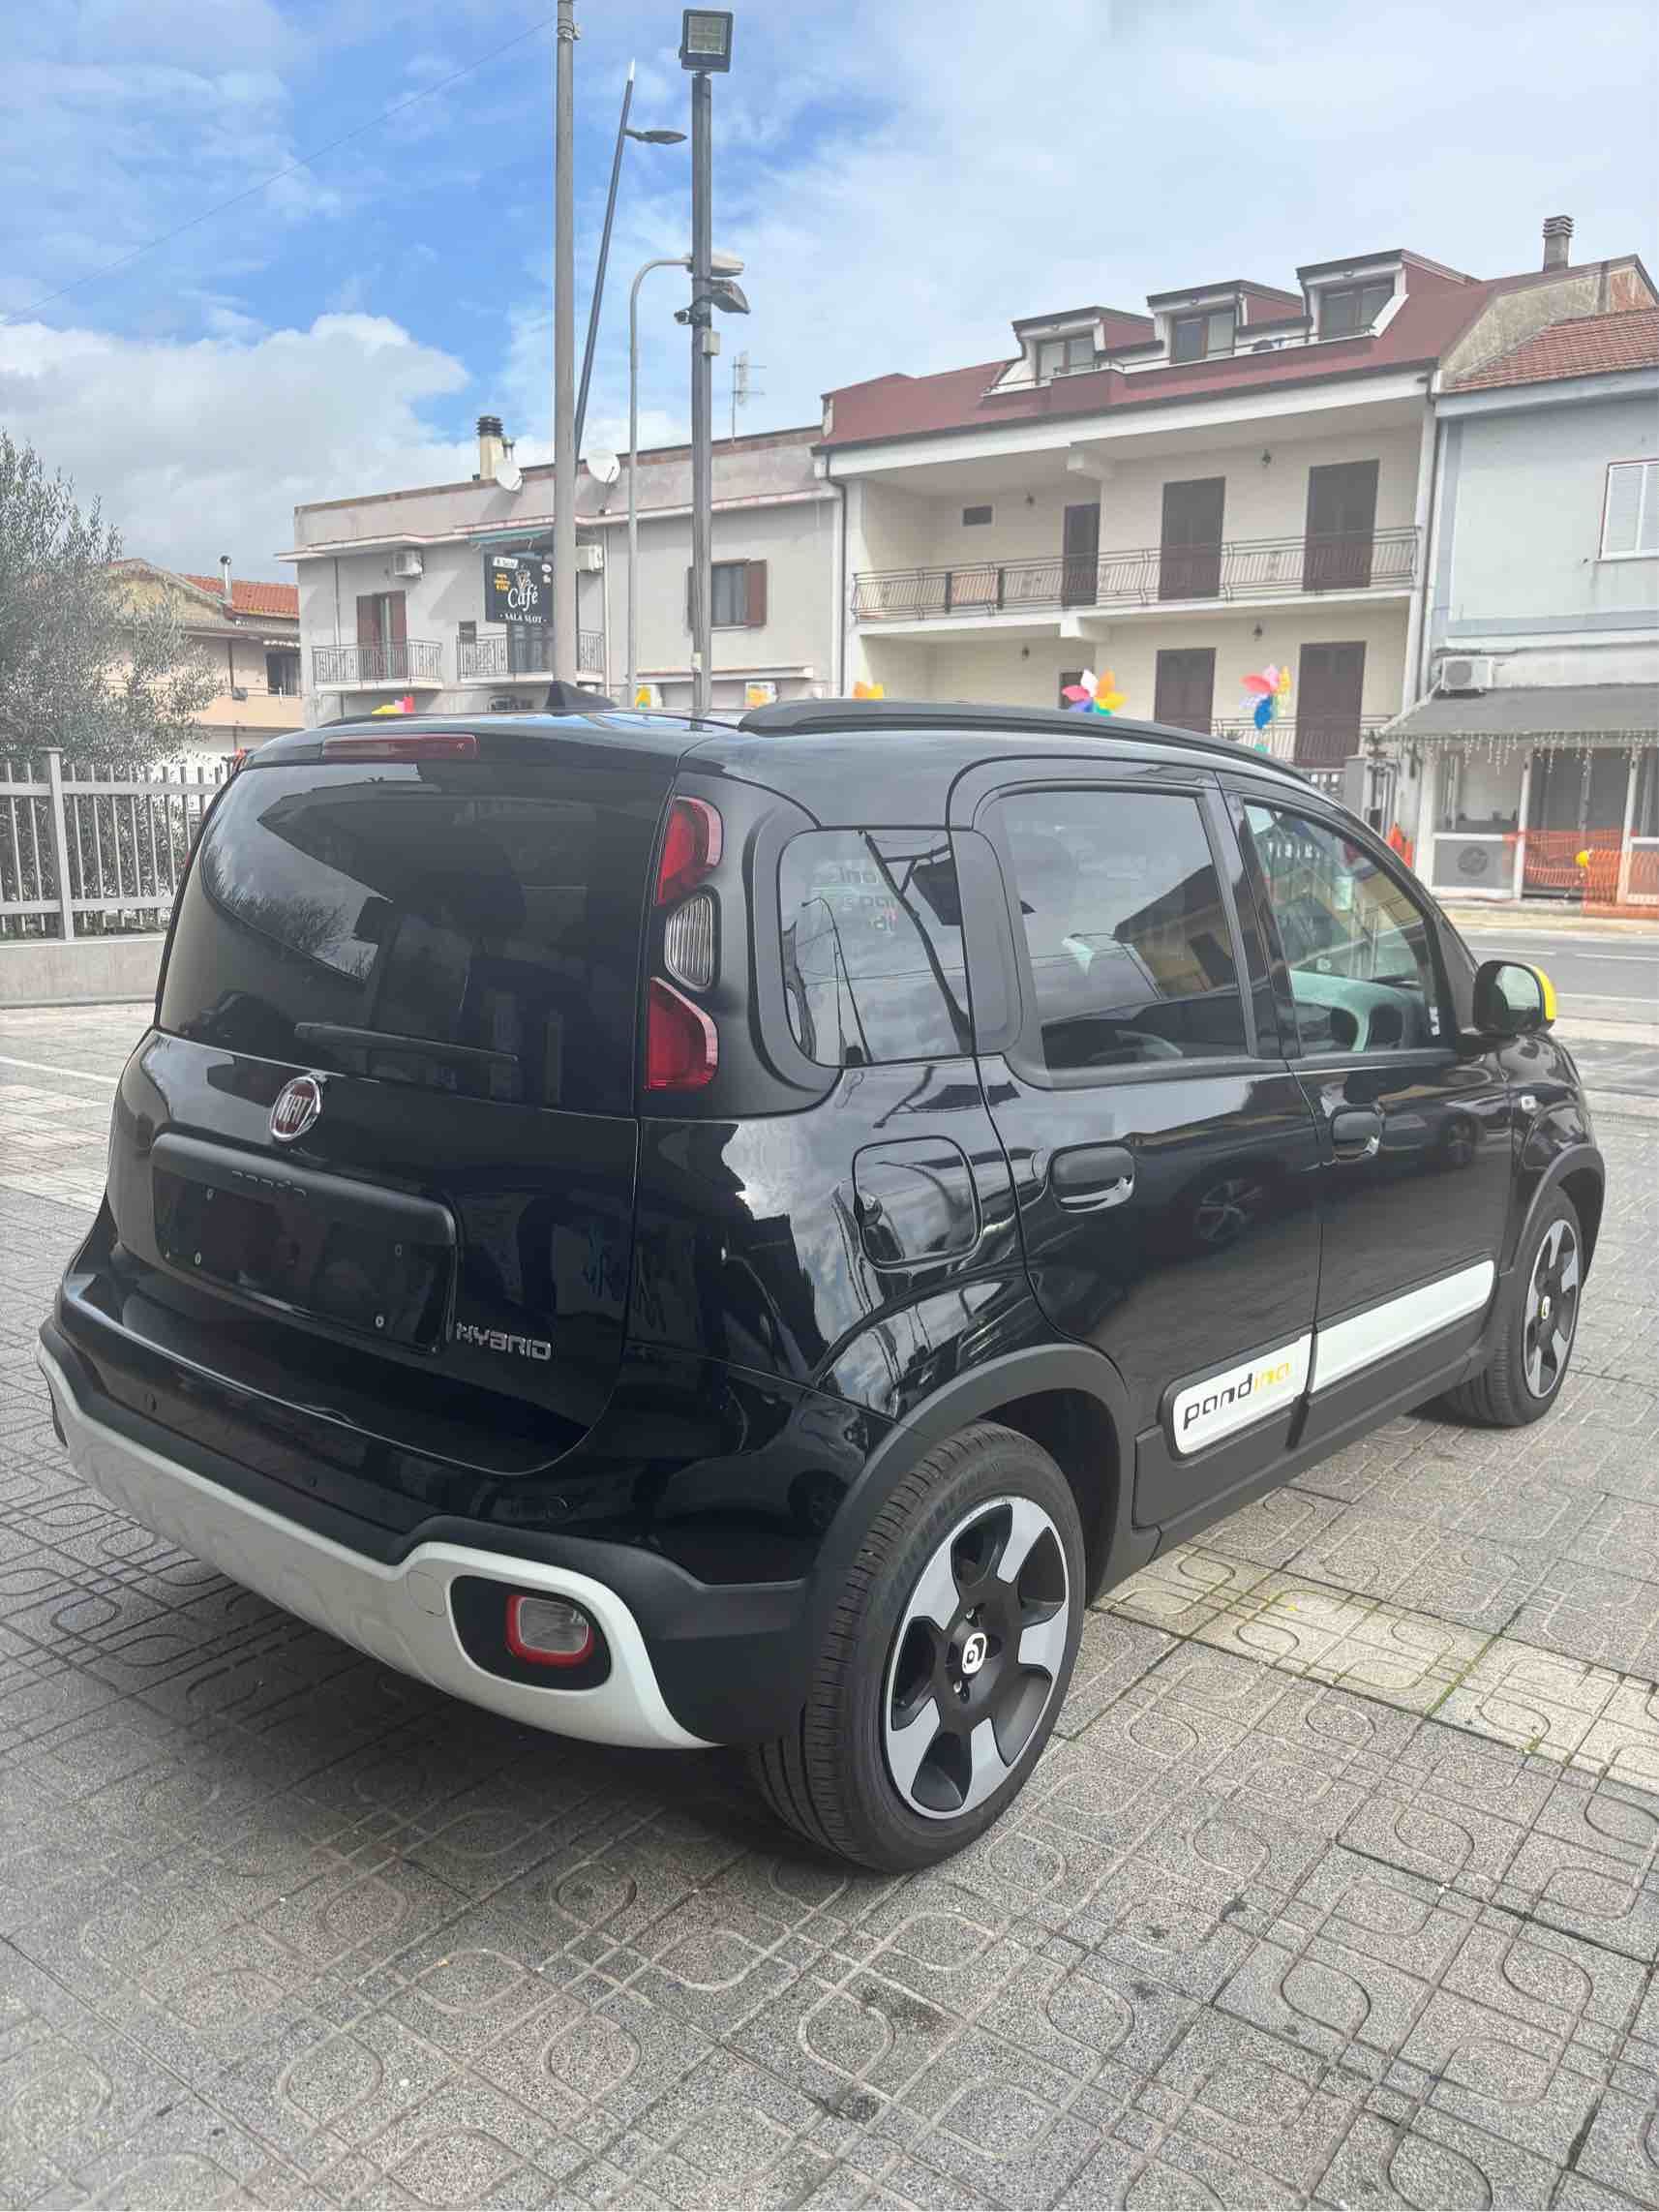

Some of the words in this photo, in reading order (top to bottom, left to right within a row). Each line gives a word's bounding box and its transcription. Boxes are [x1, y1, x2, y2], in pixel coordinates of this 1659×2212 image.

[507, 584, 538, 612] Café
[277, 1093, 311, 1124] FIAT
[456, 1321, 552, 1361] HYBRID
[1183, 1362, 1291, 1430] pandina
